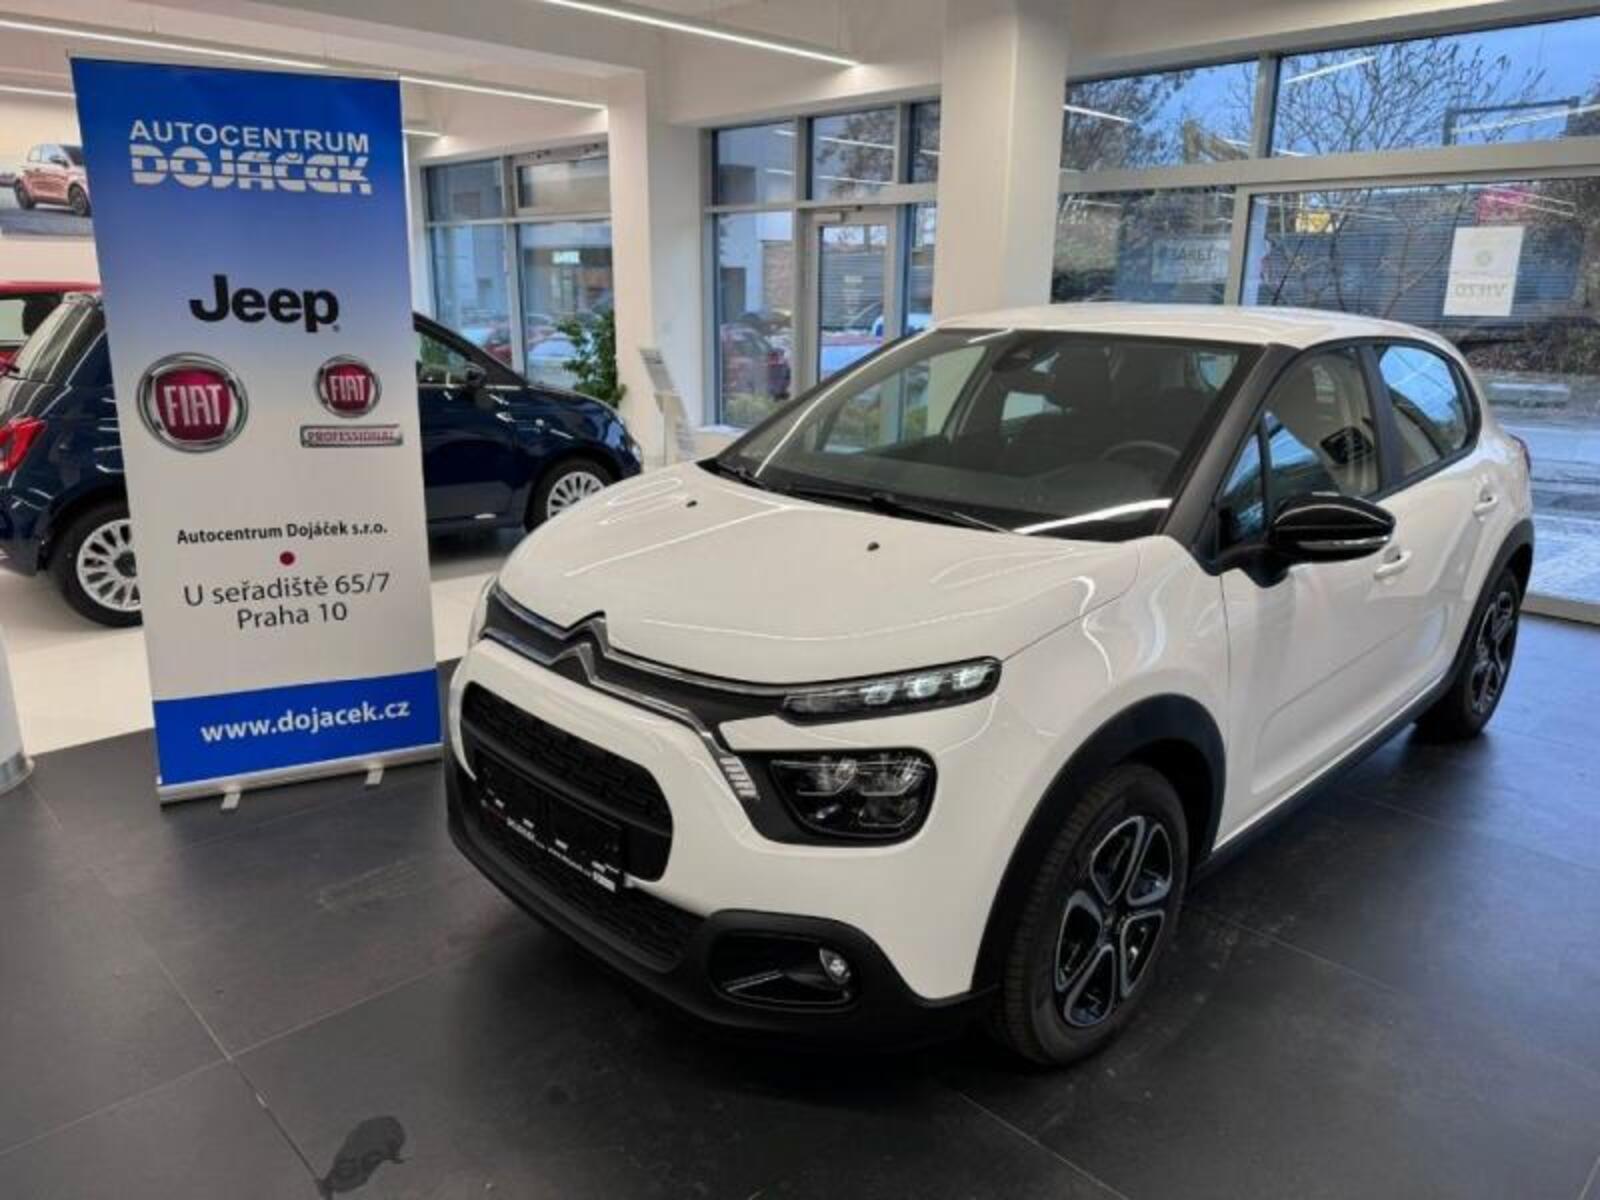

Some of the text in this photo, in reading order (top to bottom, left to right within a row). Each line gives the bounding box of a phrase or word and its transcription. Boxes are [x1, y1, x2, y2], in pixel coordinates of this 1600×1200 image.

[129, 119, 369, 153] AUTOCENTRUM
[189, 273, 339, 332] Jeep
[163, 384, 223, 427] FIAT
[329, 375, 366, 402] FIAT
[307, 431, 394, 442] PROFESSIONAL
[177, 521, 388, 545] Autocentrum Dojáček s.r.o.
[184, 572, 390, 607] U seřadiště 65/7
[237, 602, 348, 630] Praha 10
[201, 700, 410, 743] www.dojacek.cz
